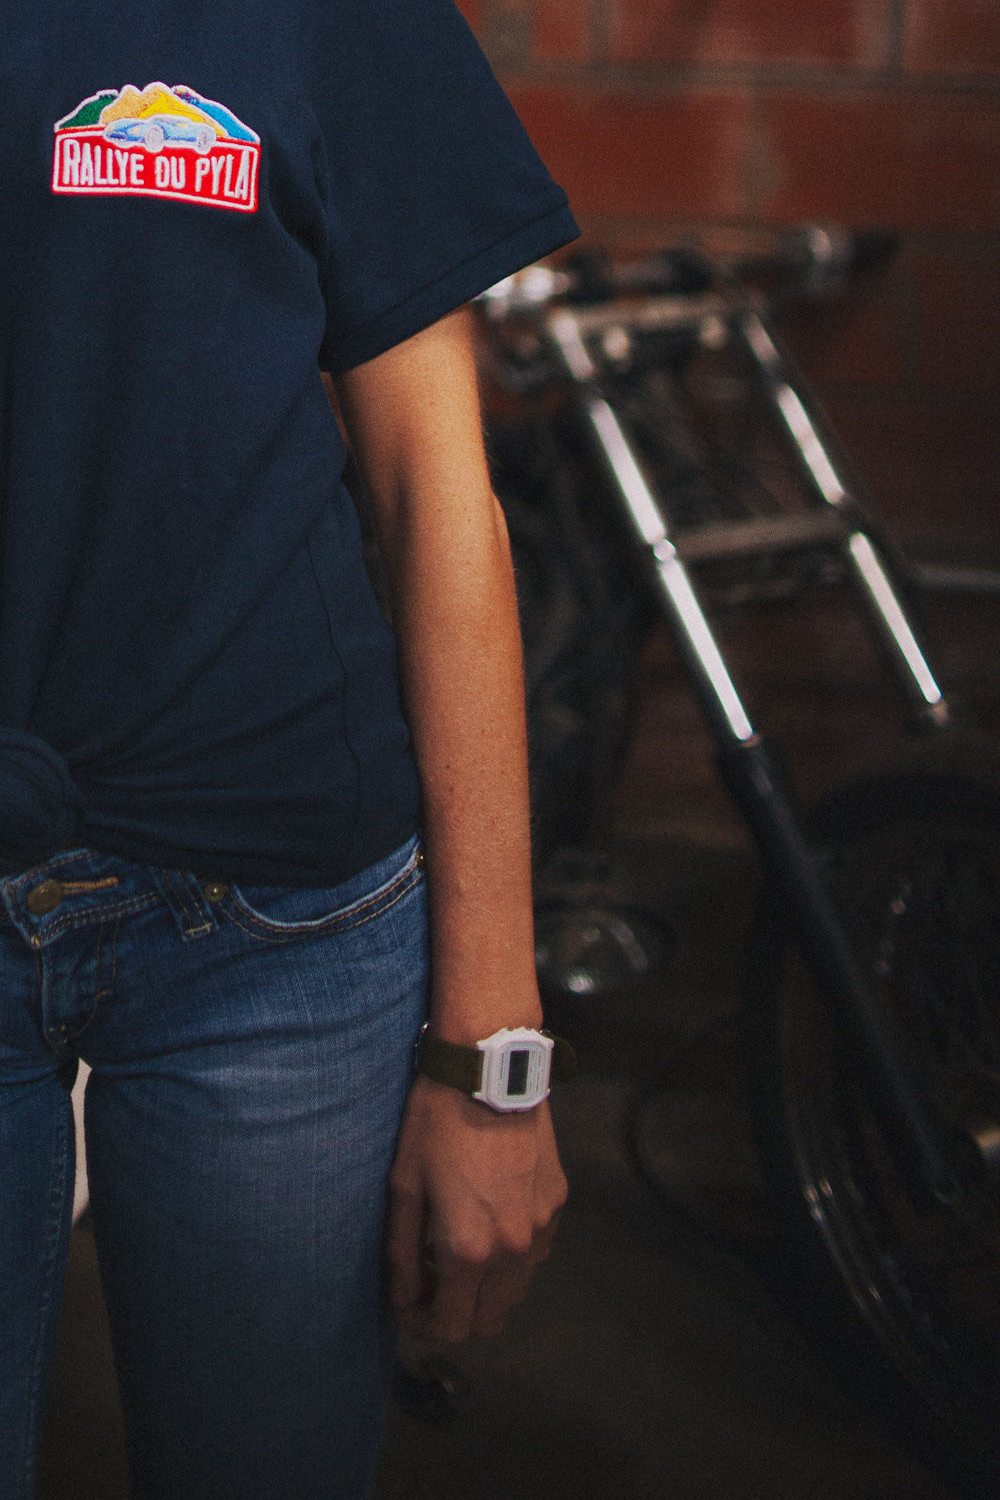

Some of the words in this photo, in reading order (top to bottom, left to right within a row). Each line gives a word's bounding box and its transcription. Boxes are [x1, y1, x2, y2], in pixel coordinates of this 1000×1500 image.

[62, 138, 145, 187] RALLYE
[154, 156, 186, 191] DU
[194, 149, 250, 201] PYLA
